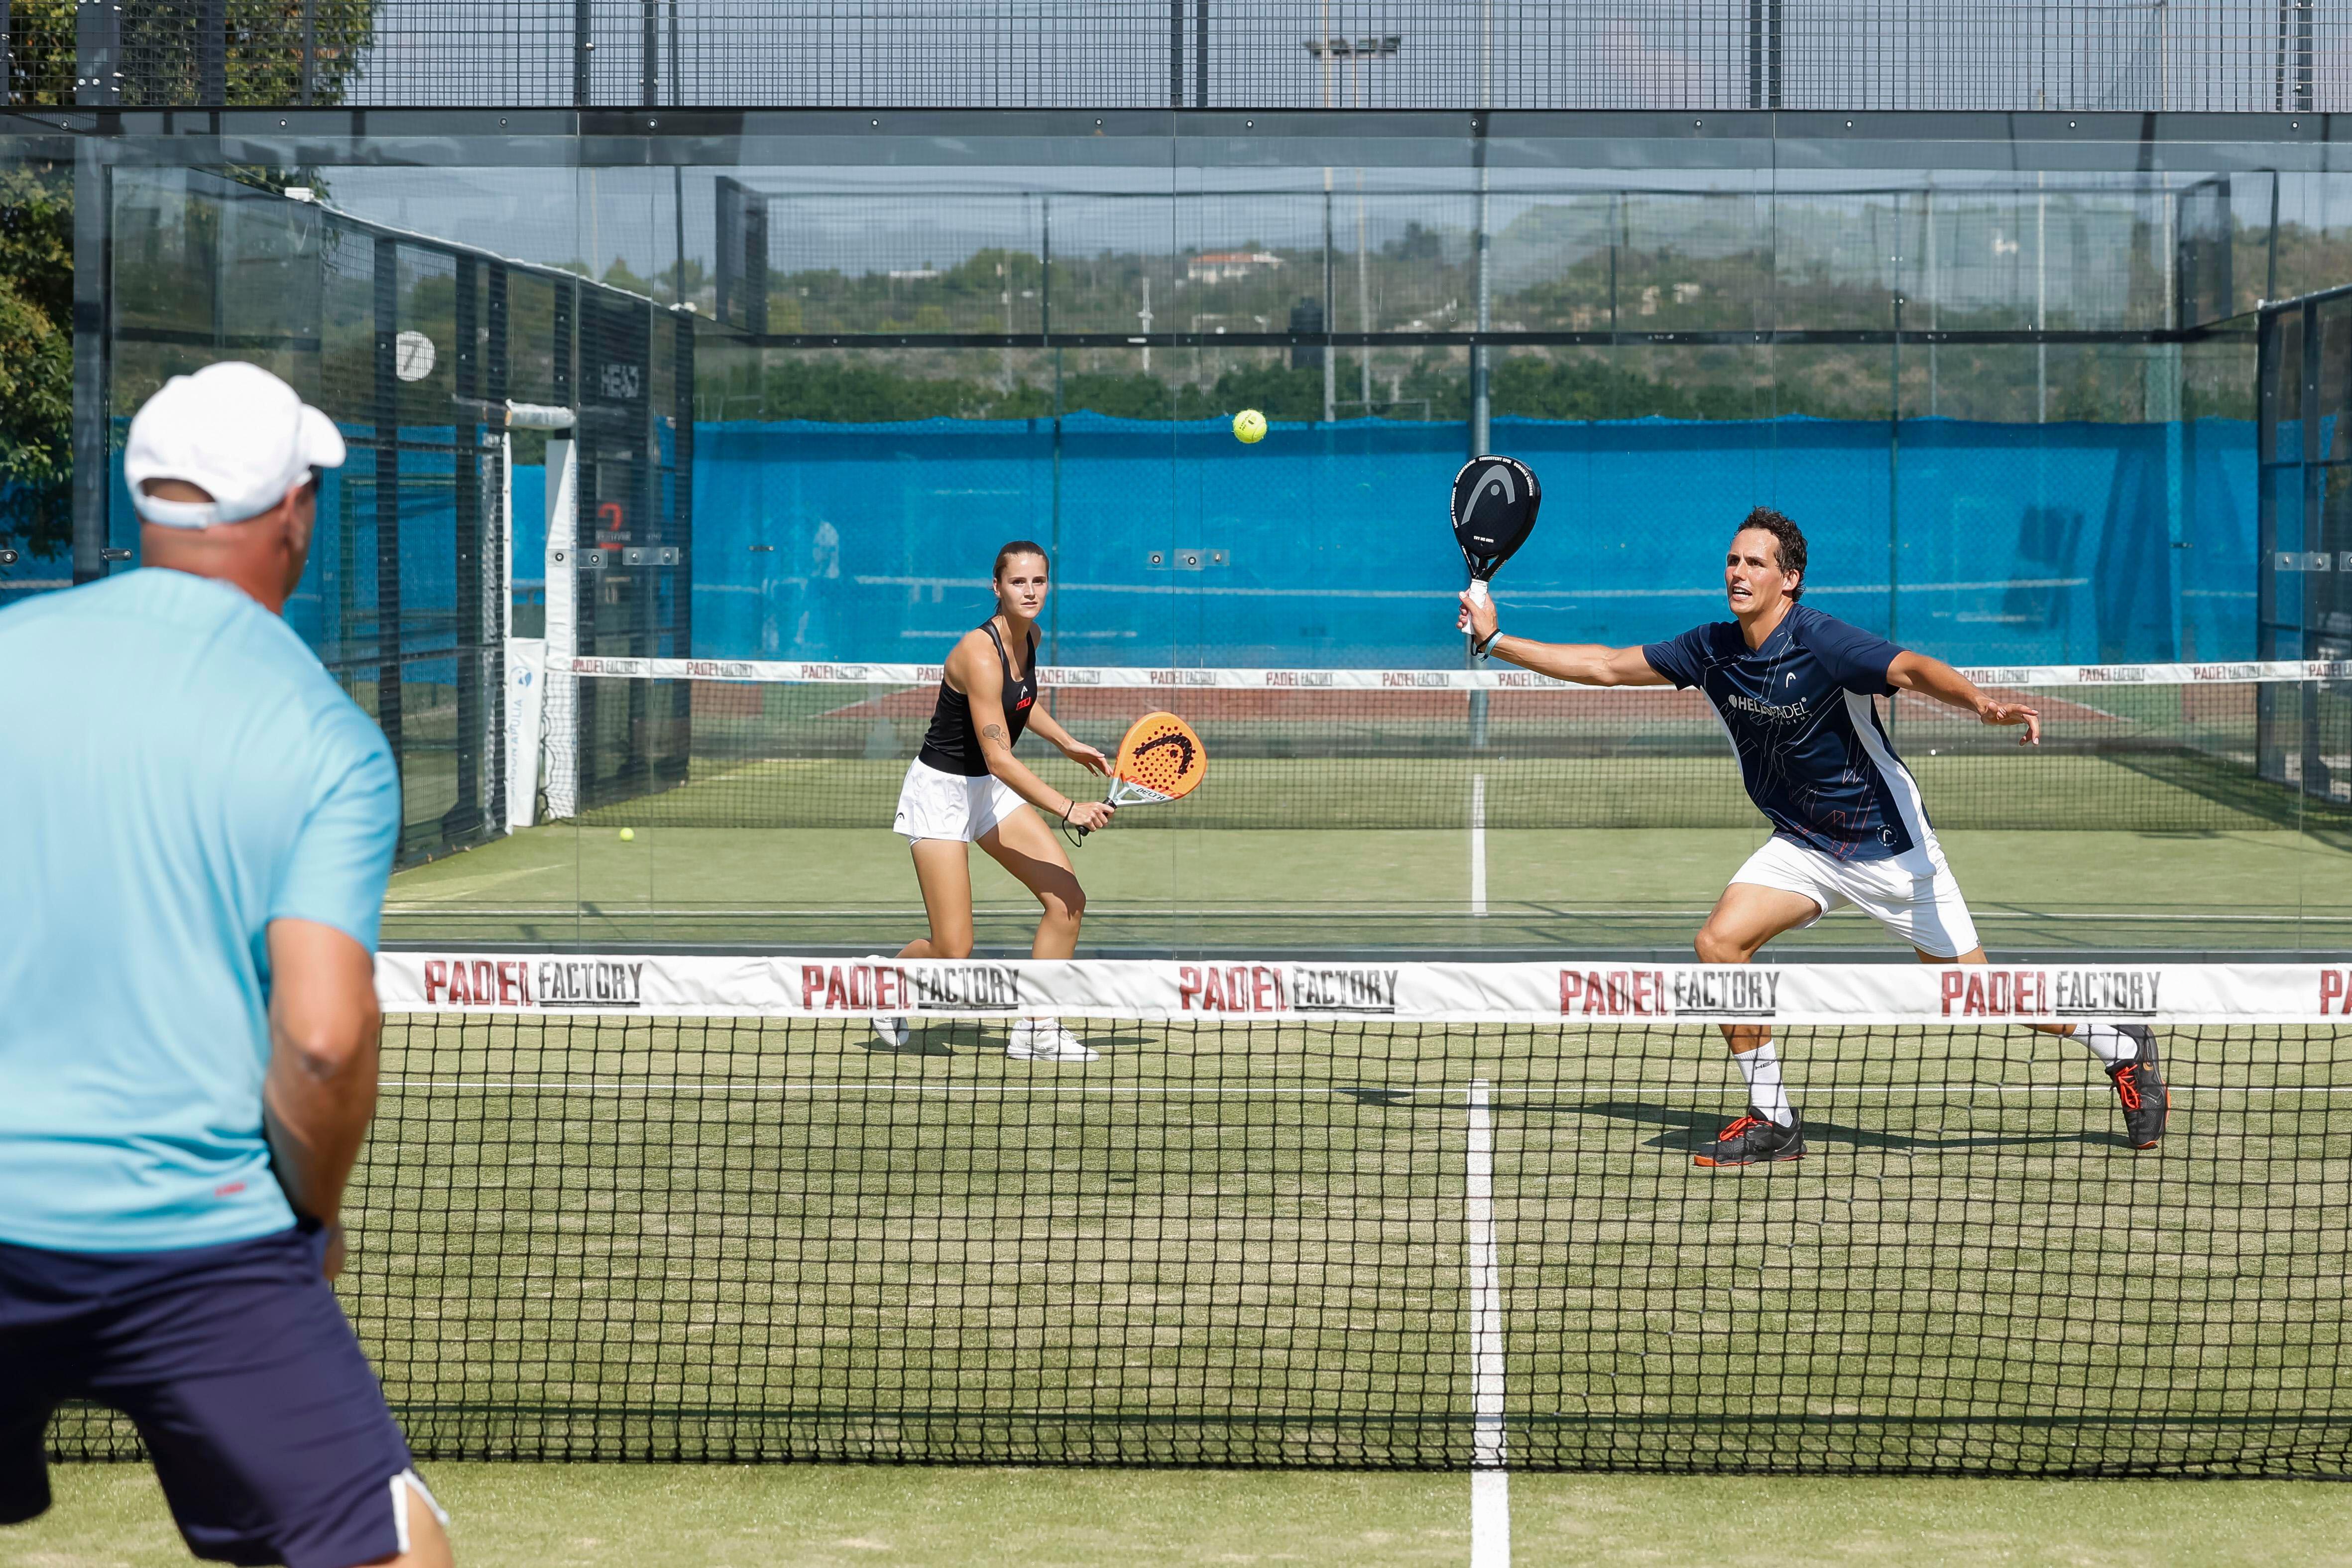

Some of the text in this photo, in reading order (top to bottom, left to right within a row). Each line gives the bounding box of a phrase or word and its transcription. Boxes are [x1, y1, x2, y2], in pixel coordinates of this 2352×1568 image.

[399, 340, 422, 371] 7
[1455, 459, 1476, 483] AERODYNAMIC
[1514, 462, 1528, 477] DURABLE
[917, 667, 943, 681] PADE
[1136, 788, 1166, 800] DELTA
[425, 960, 643, 1006] PADEL FACTORY
[802, 965, 1020, 1011] PADEL FACTORY
[1179, 966, 1400, 1012] PADEL FACTORY
[1560, 970, 1780, 1016] PADEL FACTORY
[1941, 970, 2161, 1016] PADEL FACTORY
